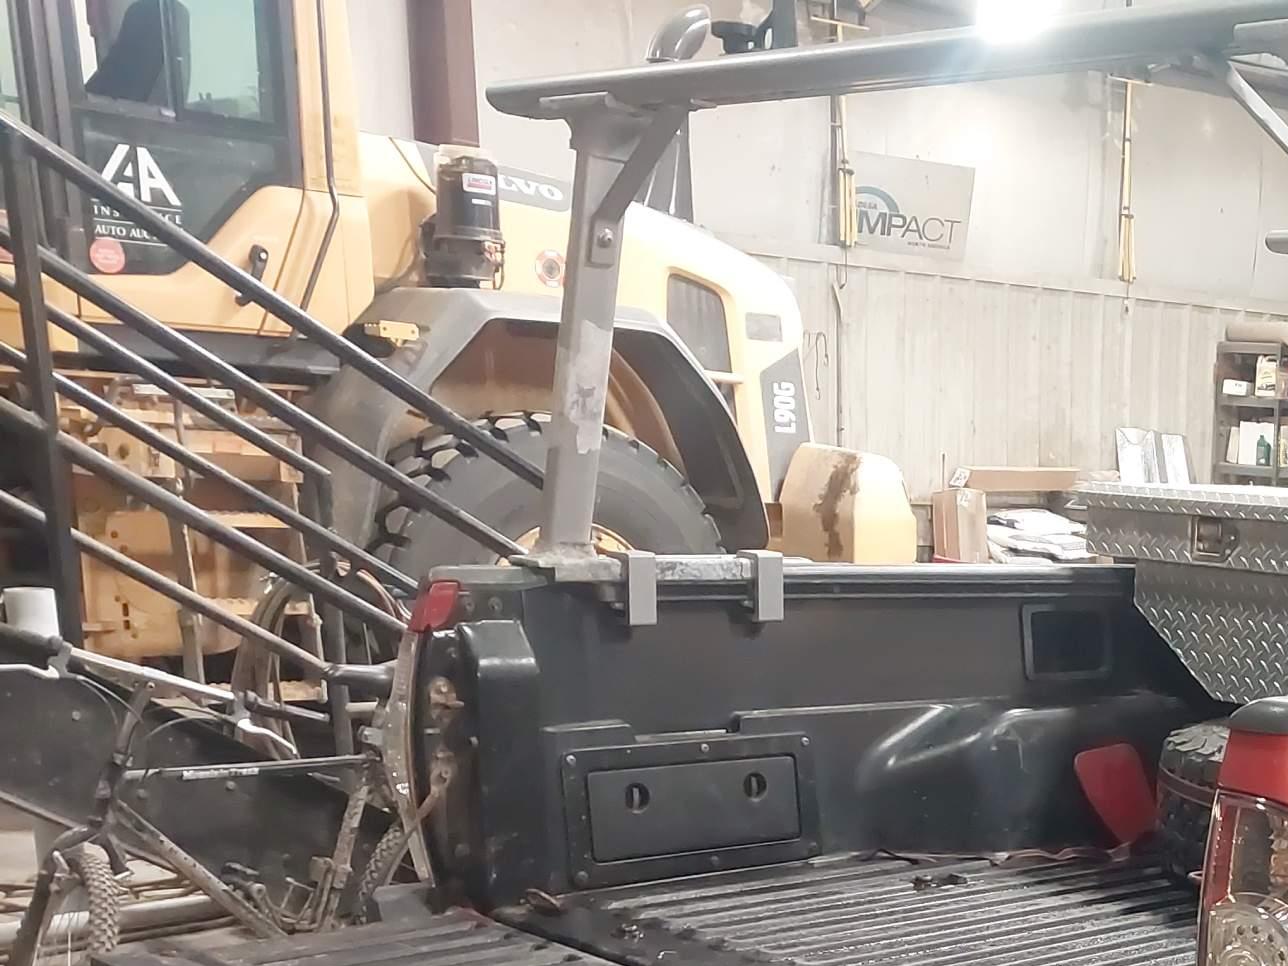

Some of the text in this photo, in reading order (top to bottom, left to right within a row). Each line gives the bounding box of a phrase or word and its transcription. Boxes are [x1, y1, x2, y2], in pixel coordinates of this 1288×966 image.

[499, 174, 564, 201] LVO
[95, 223, 126, 236] AUTO
[855, 208, 962, 245] MPACT
[773, 381, 797, 433] L90G
